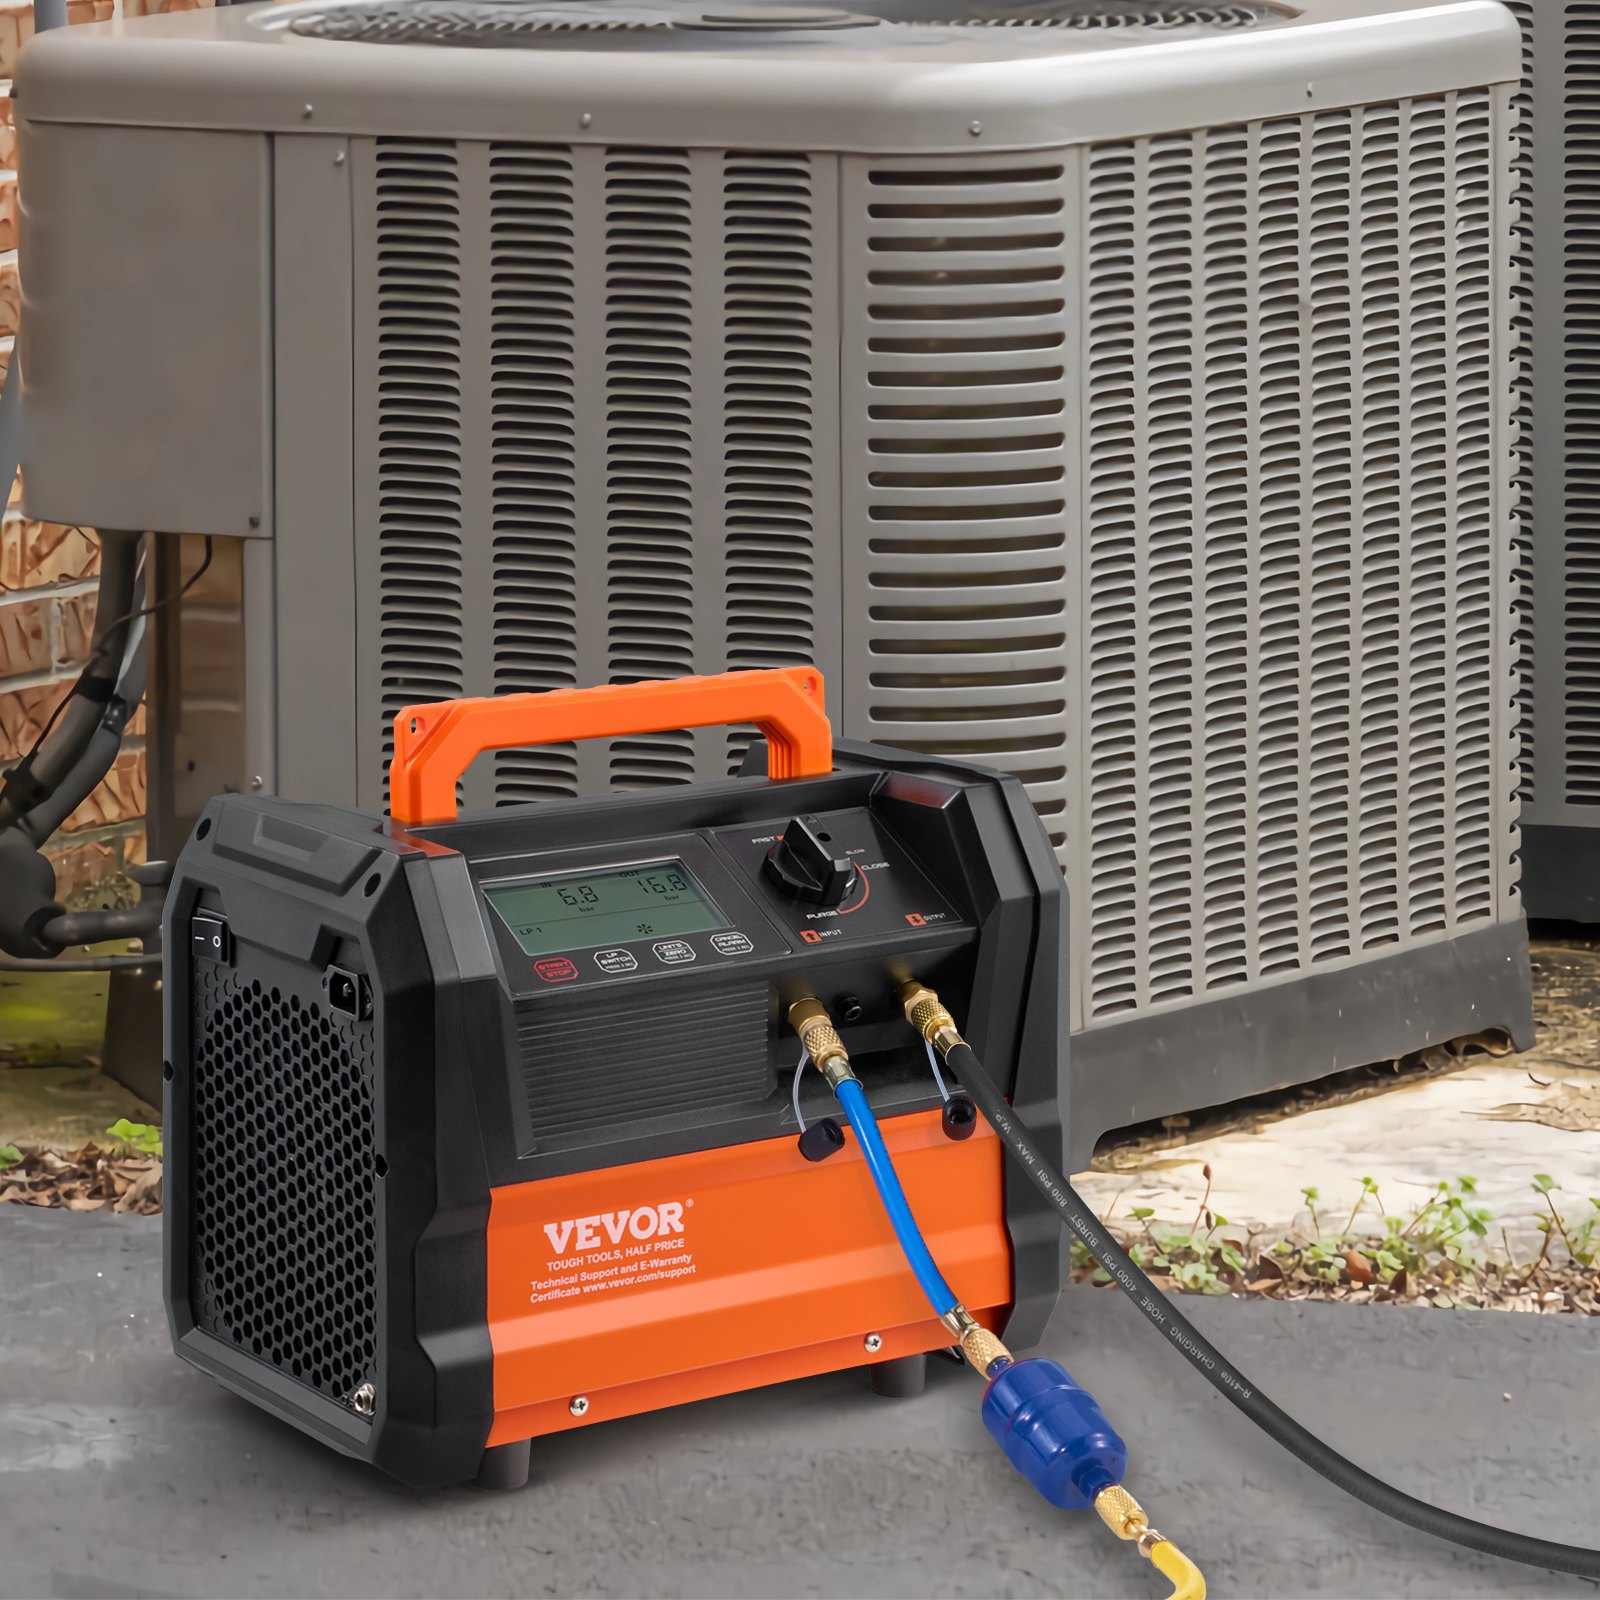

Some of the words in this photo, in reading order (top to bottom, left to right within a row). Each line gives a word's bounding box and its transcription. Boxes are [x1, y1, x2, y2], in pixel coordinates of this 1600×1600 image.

[752, 836, 776, 844] FAST
[861, 862, 890, 871] CLOSE
[637, 874, 688, 894] 16.8
[557, 886, 599, 906] 6.8
[806, 910, 838, 919] PURGE
[923, 912, 946, 921] OUTPUT
[519, 927, 533, 936] LP
[819, 929, 842, 938] INPUT
[538, 961, 569, 970] START
[600, 956, 632, 965] SWITCH
[546, 969, 572, 977] STOP
[1037, 1169, 1053, 1188] PSI
[1051, 1188, 1068, 1208] 800
[1070, 1214, 1099, 1248] BURST
[546, 1256, 584, 1272] TOUGH
[586, 1249, 624, 1263] TOOLS,
[625, 1243, 652, 1257] HALF
[654, 1238, 685, 1252] PRICE
[1102, 1252, 1118, 1271] PSI
[530, 1273, 578, 1291] Technical
[580, 1267, 618, 1283] Support
[620, 1263, 638, 1275] and
[640, 1254, 692, 1270] E-Warranty
[1117, 1269, 1137, 1292] 4000
[530, 1286, 581, 1303] Certificate
[583, 1264, 697, 1294] www.vevor.com/support
[1140, 1296, 1166, 1324] HOSE
[1170, 1326, 1215, 1370] CHARGING
